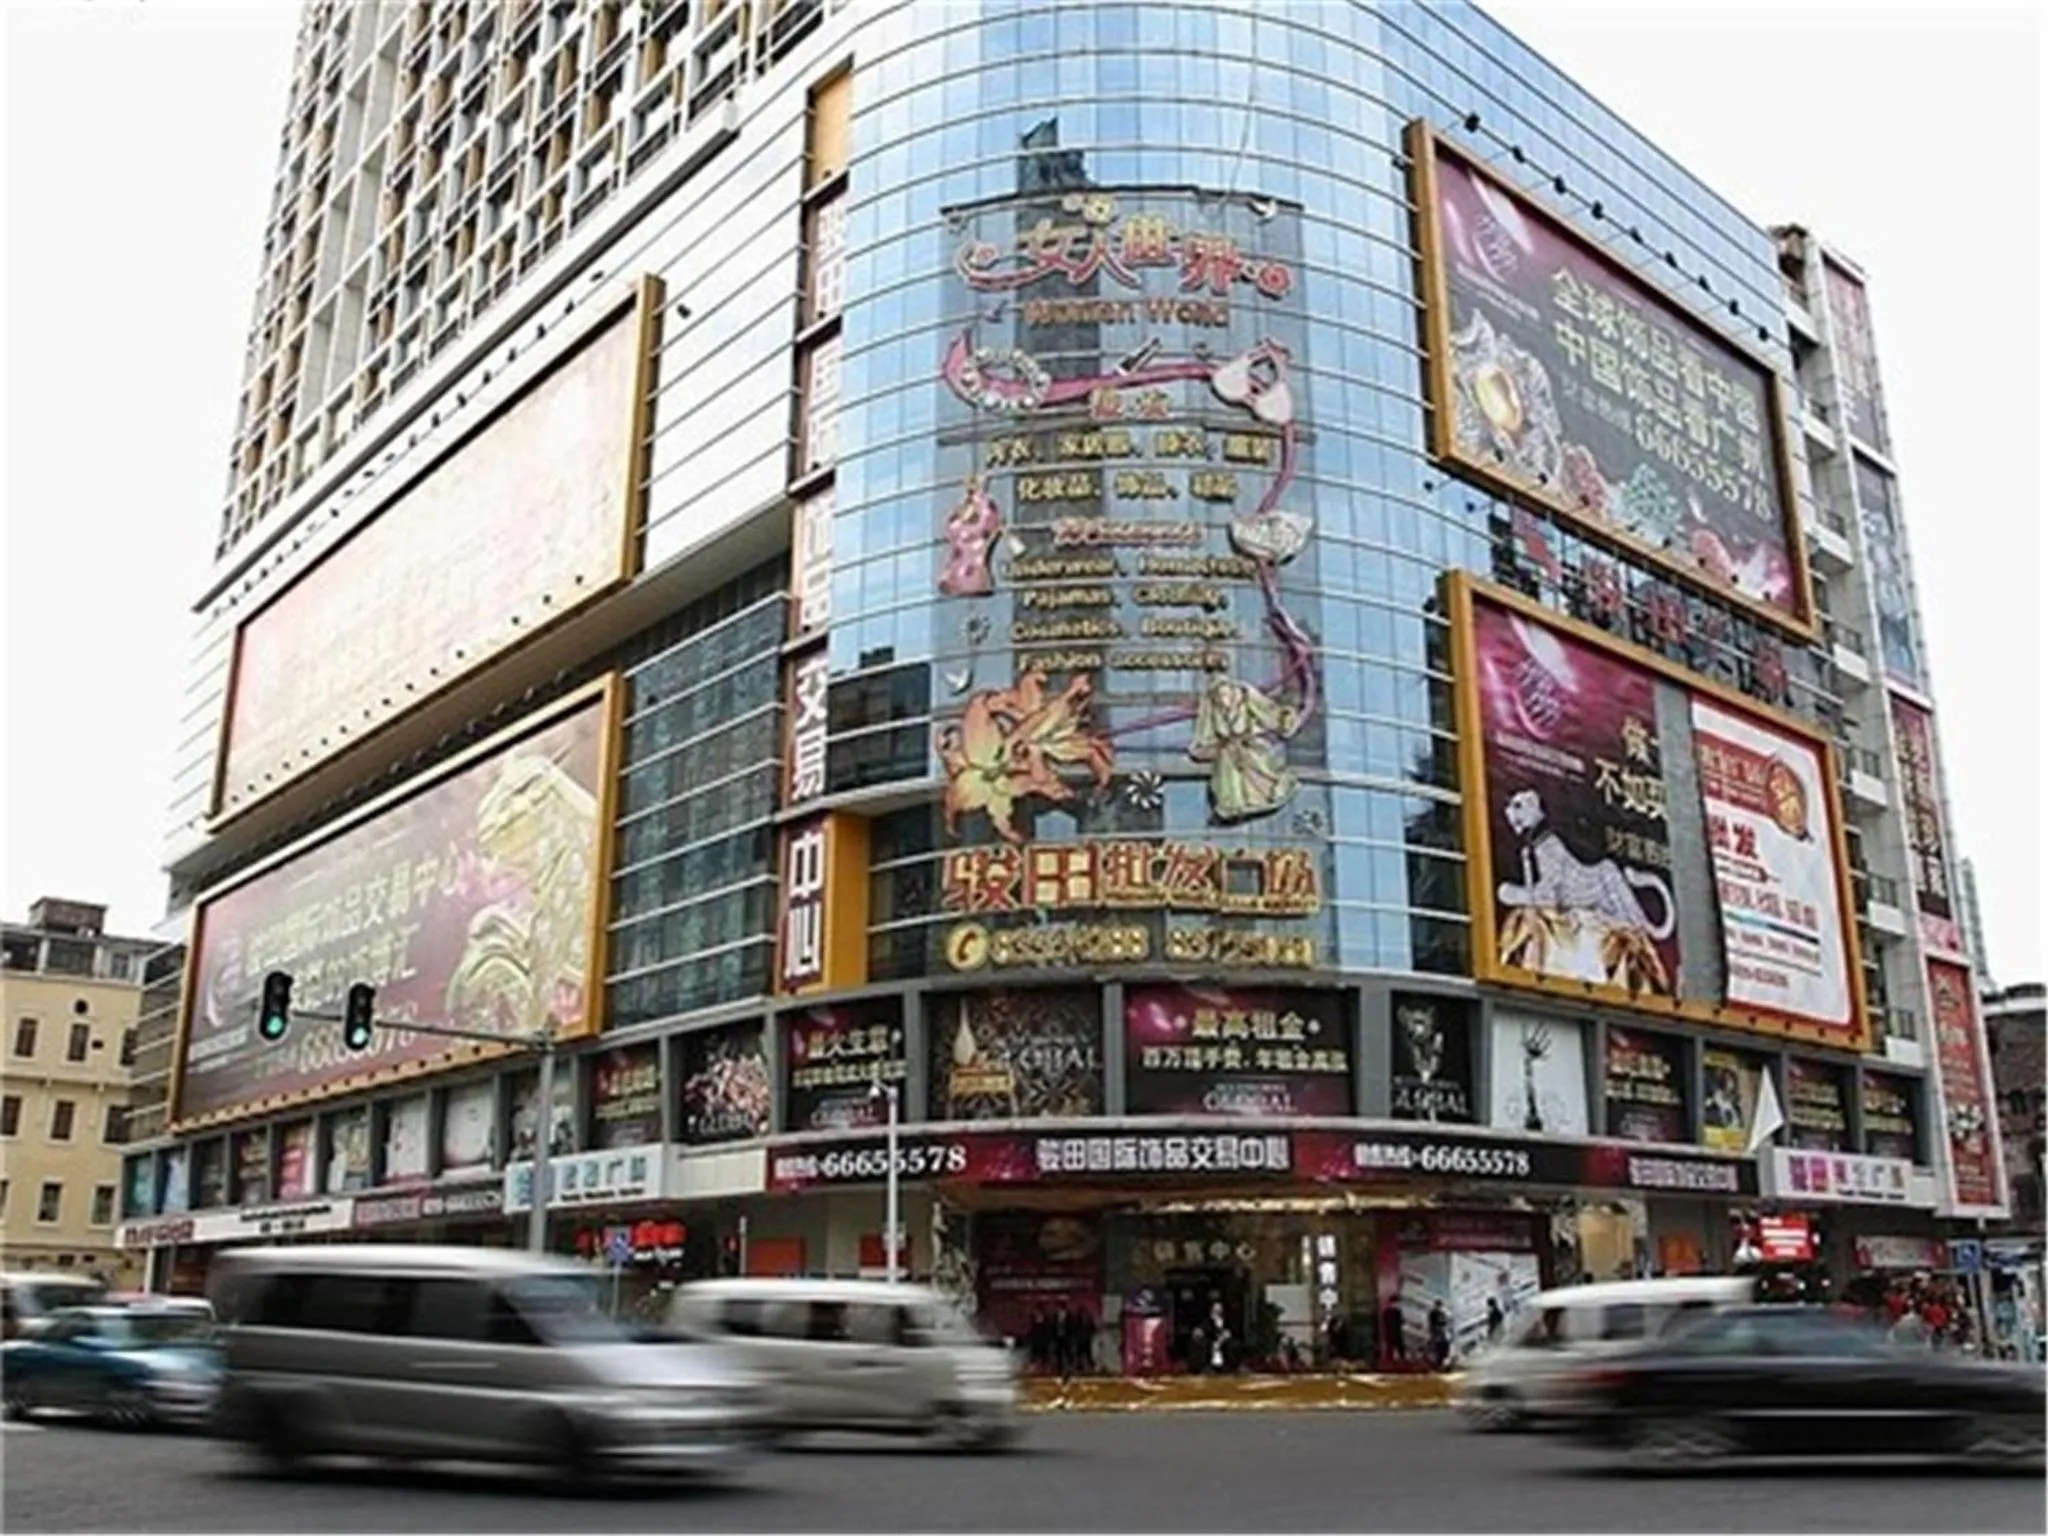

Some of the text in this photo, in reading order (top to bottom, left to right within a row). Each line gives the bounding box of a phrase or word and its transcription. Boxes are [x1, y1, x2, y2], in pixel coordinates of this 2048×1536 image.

[956, 214, 1240, 294] 女人世界
[1420, 1144, 1531, 1177] 66655578
